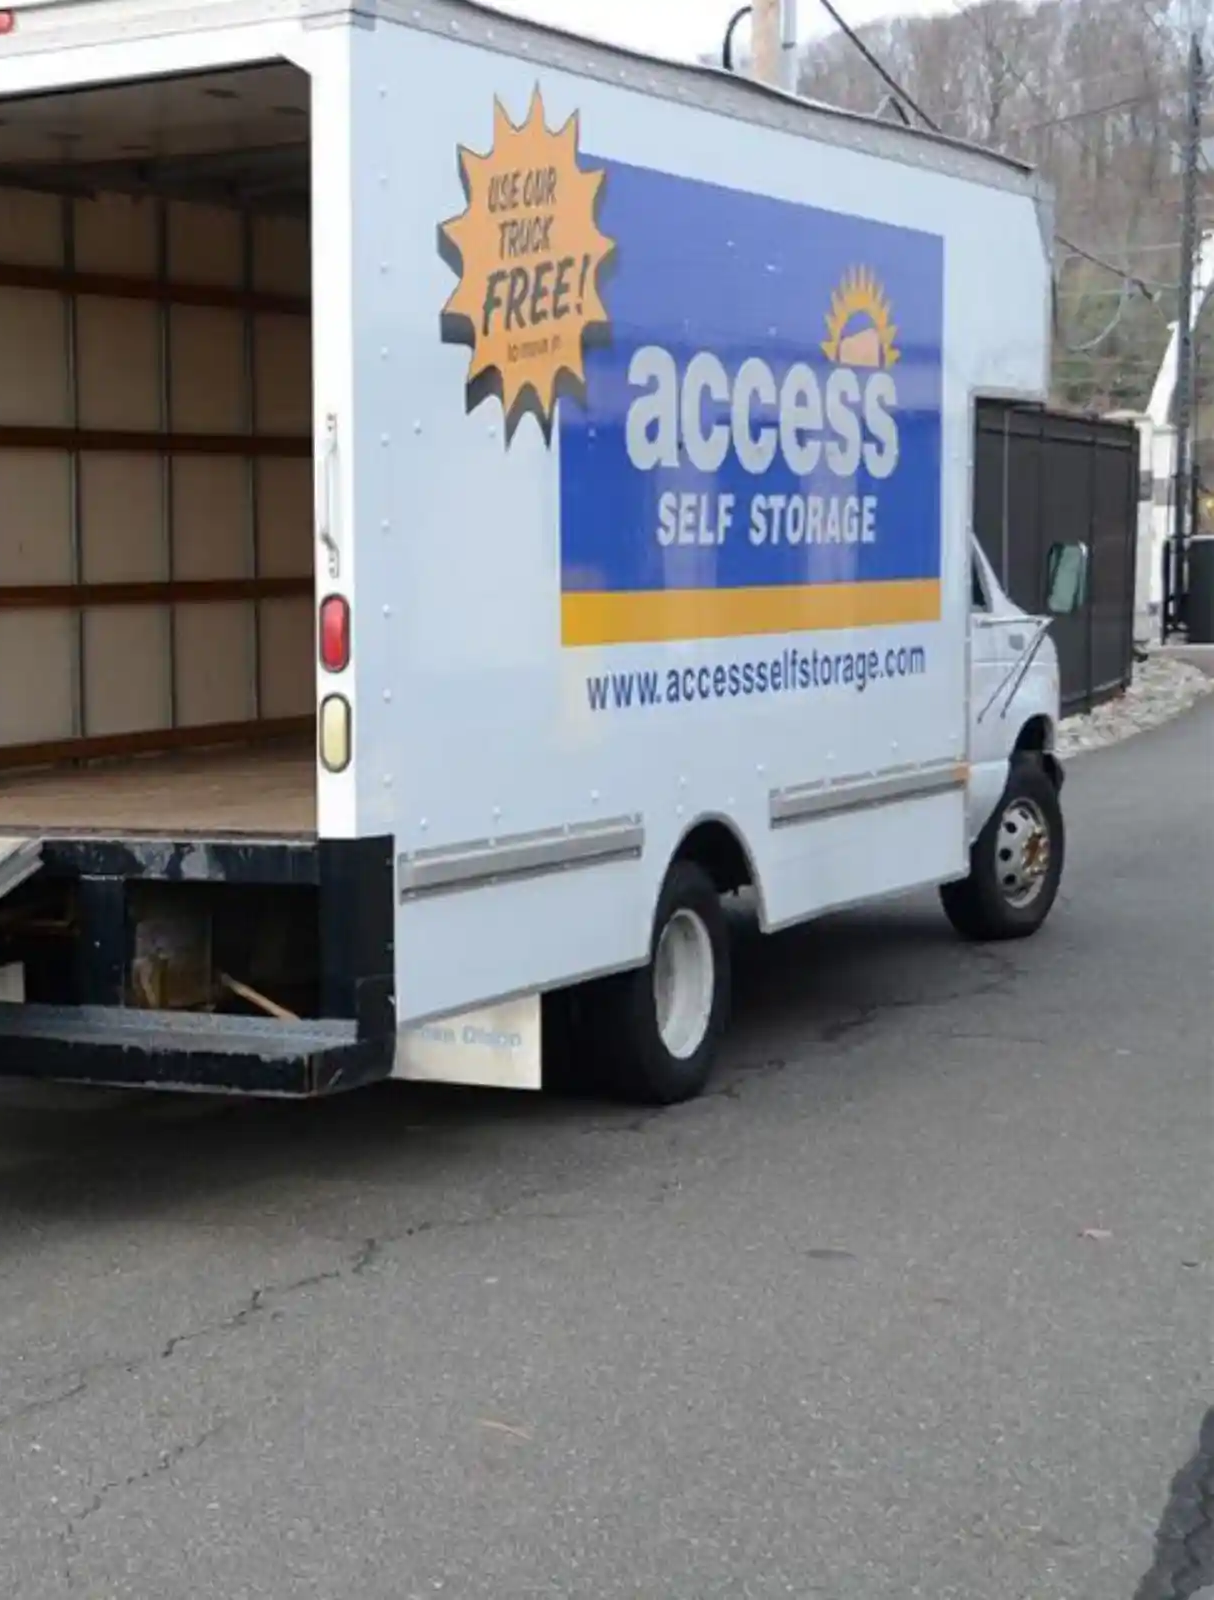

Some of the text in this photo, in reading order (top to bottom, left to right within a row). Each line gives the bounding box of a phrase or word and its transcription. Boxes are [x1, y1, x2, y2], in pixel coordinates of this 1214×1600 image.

[488, 166, 557, 212] USE OUR
[498, 215, 554, 260] TRUCK
[482, 253, 590, 337] FREE!
[625, 345, 900, 479] access
[656, 491, 878, 546] SELF STORAGE
[586, 644, 927, 710] www.accessselfstorage.com
